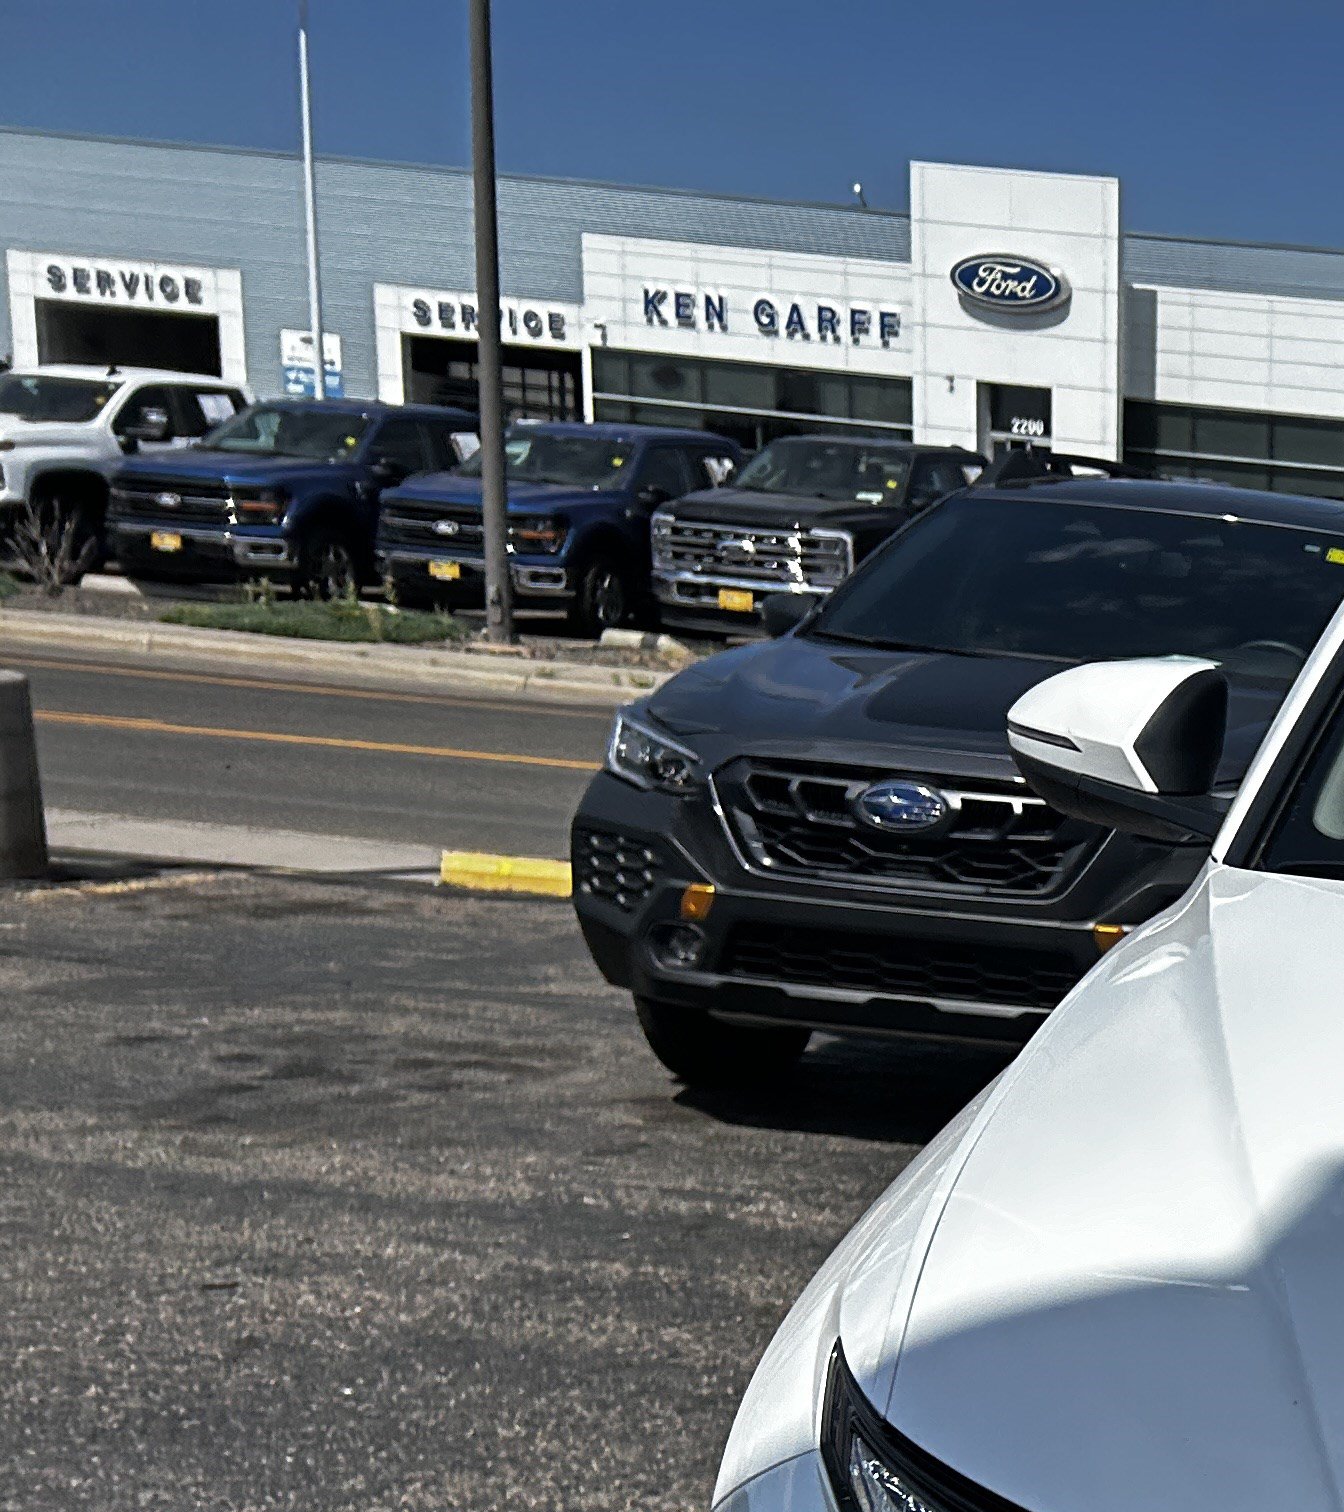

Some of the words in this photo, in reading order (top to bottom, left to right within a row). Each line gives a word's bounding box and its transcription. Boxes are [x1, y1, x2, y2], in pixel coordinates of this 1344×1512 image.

[46, 263, 204, 305] SERVICE
[972, 262, 1039, 299] Ford
[412, 298, 566, 341] SERICE
[642, 287, 729, 333] KEN
[752, 297, 901, 349] GARFF
